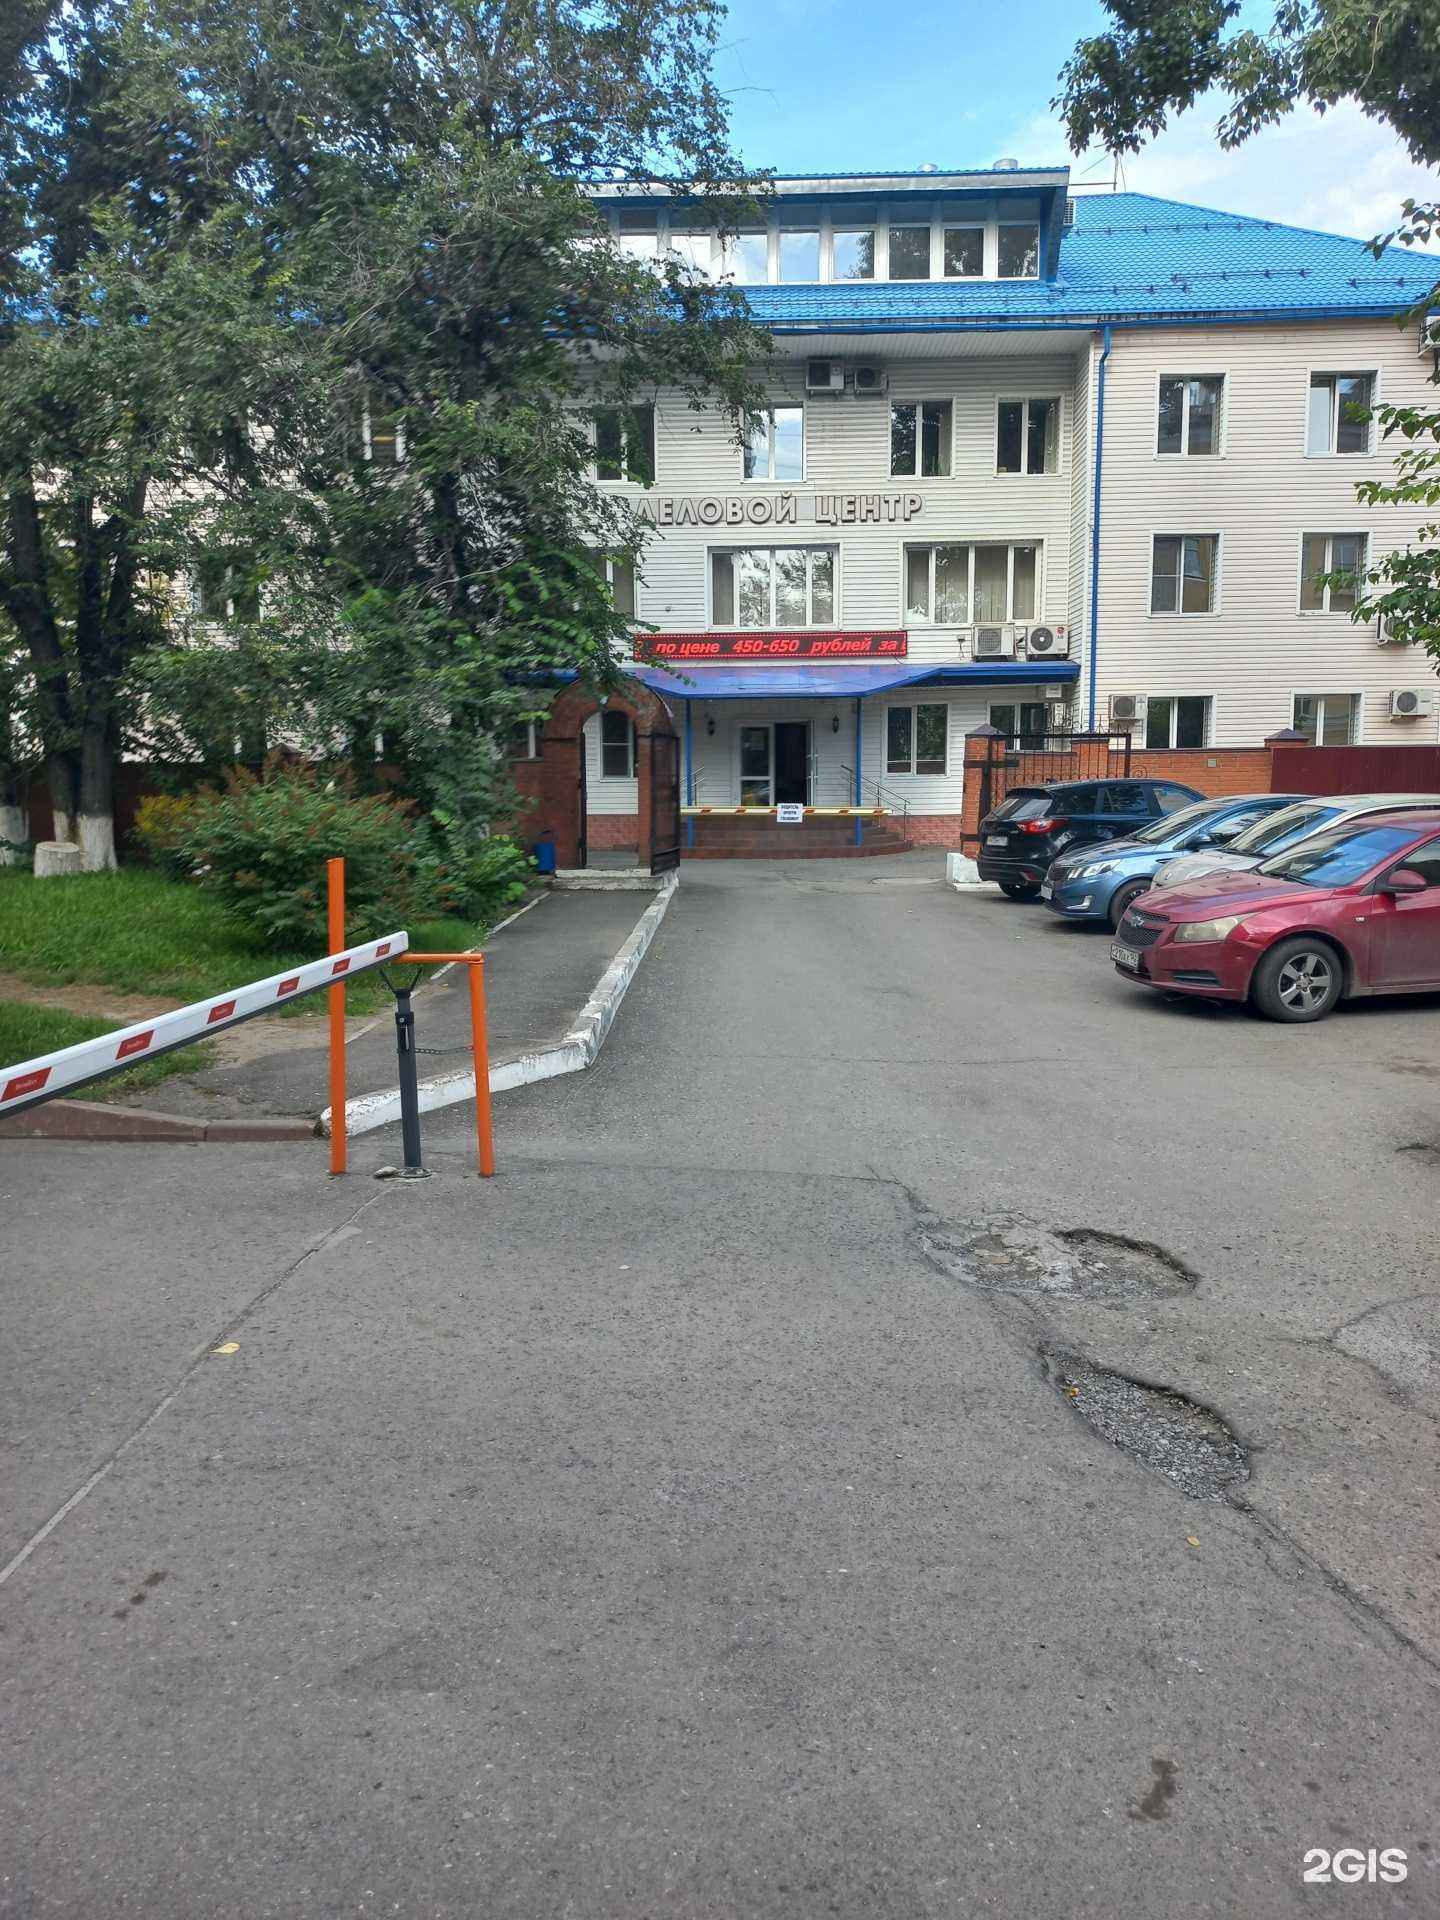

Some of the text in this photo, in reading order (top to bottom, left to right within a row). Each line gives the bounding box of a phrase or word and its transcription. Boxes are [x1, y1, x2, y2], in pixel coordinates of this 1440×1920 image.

[815, 493, 922, 526] ЦЕНТР
[655, 643, 676, 654] по
[680, 642, 720, 656] цене
[732, 639, 800, 653] 450-650
[810, 636, 872, 654] рублей
[878, 640, 899, 651] за
